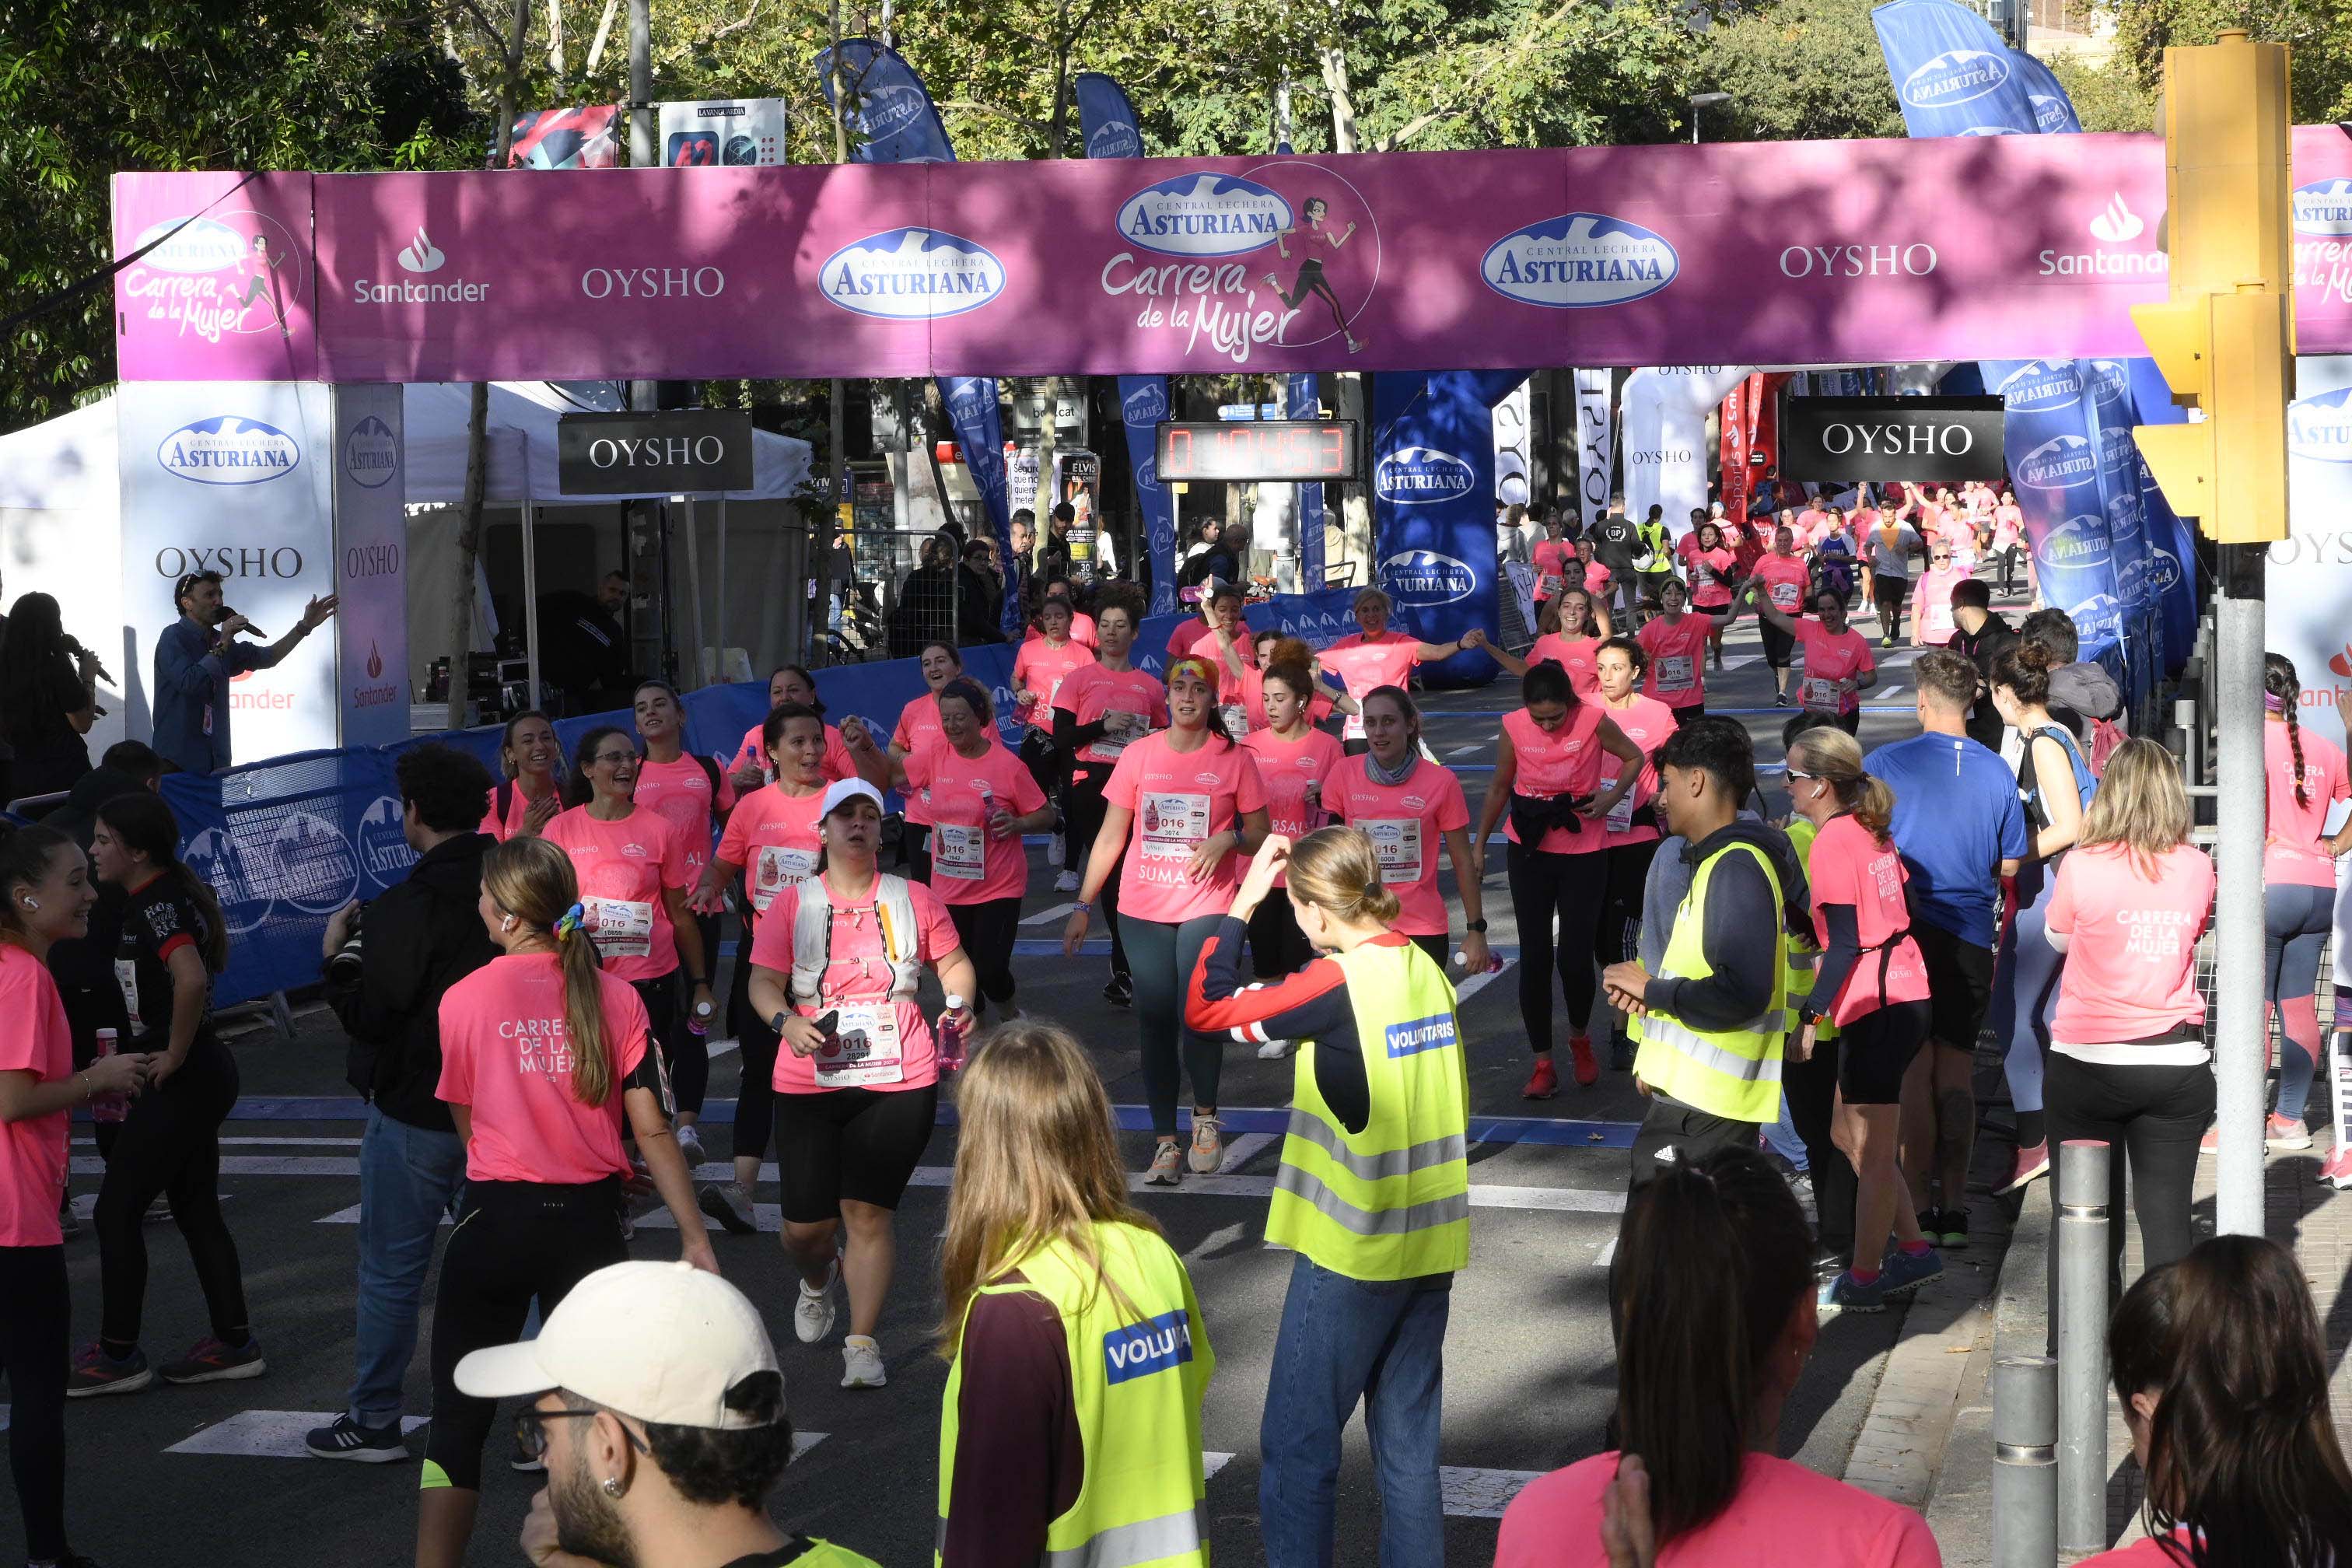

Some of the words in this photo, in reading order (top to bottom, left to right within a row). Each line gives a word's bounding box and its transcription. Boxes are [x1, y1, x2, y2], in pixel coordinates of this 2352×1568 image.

[1157, 201, 1213, 210] CENTRAL
[1218, 200, 1274, 209] LECHERA
[1129, 204, 1279, 236] ASTURIANA
[1527, 246, 1588, 257] CENTRAL
[1594, 244, 1657, 255] LECHERA
[926, 258, 985, 268] LECHERA
[1496, 249, 1664, 284] ASTURIANA
[1780, 243, 1937, 278] OYSHO
[2039, 250, 2170, 275] Santand
[125, 268, 218, 298] Carrera
[582, 266, 725, 299] OYSHO
[833, 263, 991, 296] ASTURIANA
[1101, 252, 1246, 296] Carrera
[355, 278, 489, 304] Santander
[148, 298, 165, 319] de
[169, 297, 182, 319] la
[179, 294, 253, 344] Mujer
[1137, 298, 1164, 327] de
[1170, 296, 1189, 327] la
[1185, 285, 1301, 363] Mujer
[1822, 422, 1972, 456] OYSHO
[168, 441, 290, 468] ASTURIANA
[349, 442, 394, 471] ASTURIANA
[589, 436, 724, 468] OYSHO
[1633, 450, 1692, 465] OYSHO
[1073, 463, 1096, 473] ELVIS
[1378, 470, 1468, 492] ASTURIANA
[1729, 450, 1745, 509] Sports
[2267, 531, 2352, 565] OYS
[156, 547, 303, 579] OYSHO
[347, 544, 399, 579] OYSHO
[354, 683, 398, 709] Santander
[2284, 761, 2326, 777] CAERA
[2304, 777, 2315, 787] LA
[1351, 794, 1379, 803] OYSHO
[760, 823, 787, 831] OYSHO
[1161, 818, 1185, 828] 016
[1272, 819, 1304, 834] RSAL
[569, 845, 598, 855] OYSHO
[946, 845, 964, 854] 016
[1375, 845, 1398, 854] 016
[1139, 865, 1186, 884] SUMA
[1868, 855, 1897, 876] CARRERA
[1877, 873, 1886, 885] DE
[1888, 869, 1895, 881] LA
[1878, 881, 1899, 899] MUJER
[601, 918, 626, 928] 016
[2116, 909, 2192, 926] CARRERA
[2130, 924, 2153, 939] DE
[2158, 926, 2179, 940] LA
[2126, 939, 2179, 955] MUJER
[841, 1019, 873, 1027] ASTURIANA
[843, 1037, 873, 1050] 016
[1388, 1021, 1454, 1050] VOLUNTARIS
[520, 1038, 542, 1055] DE
[549, 1037, 573, 1055] LA
[846, 1052, 870, 1061] 28291
